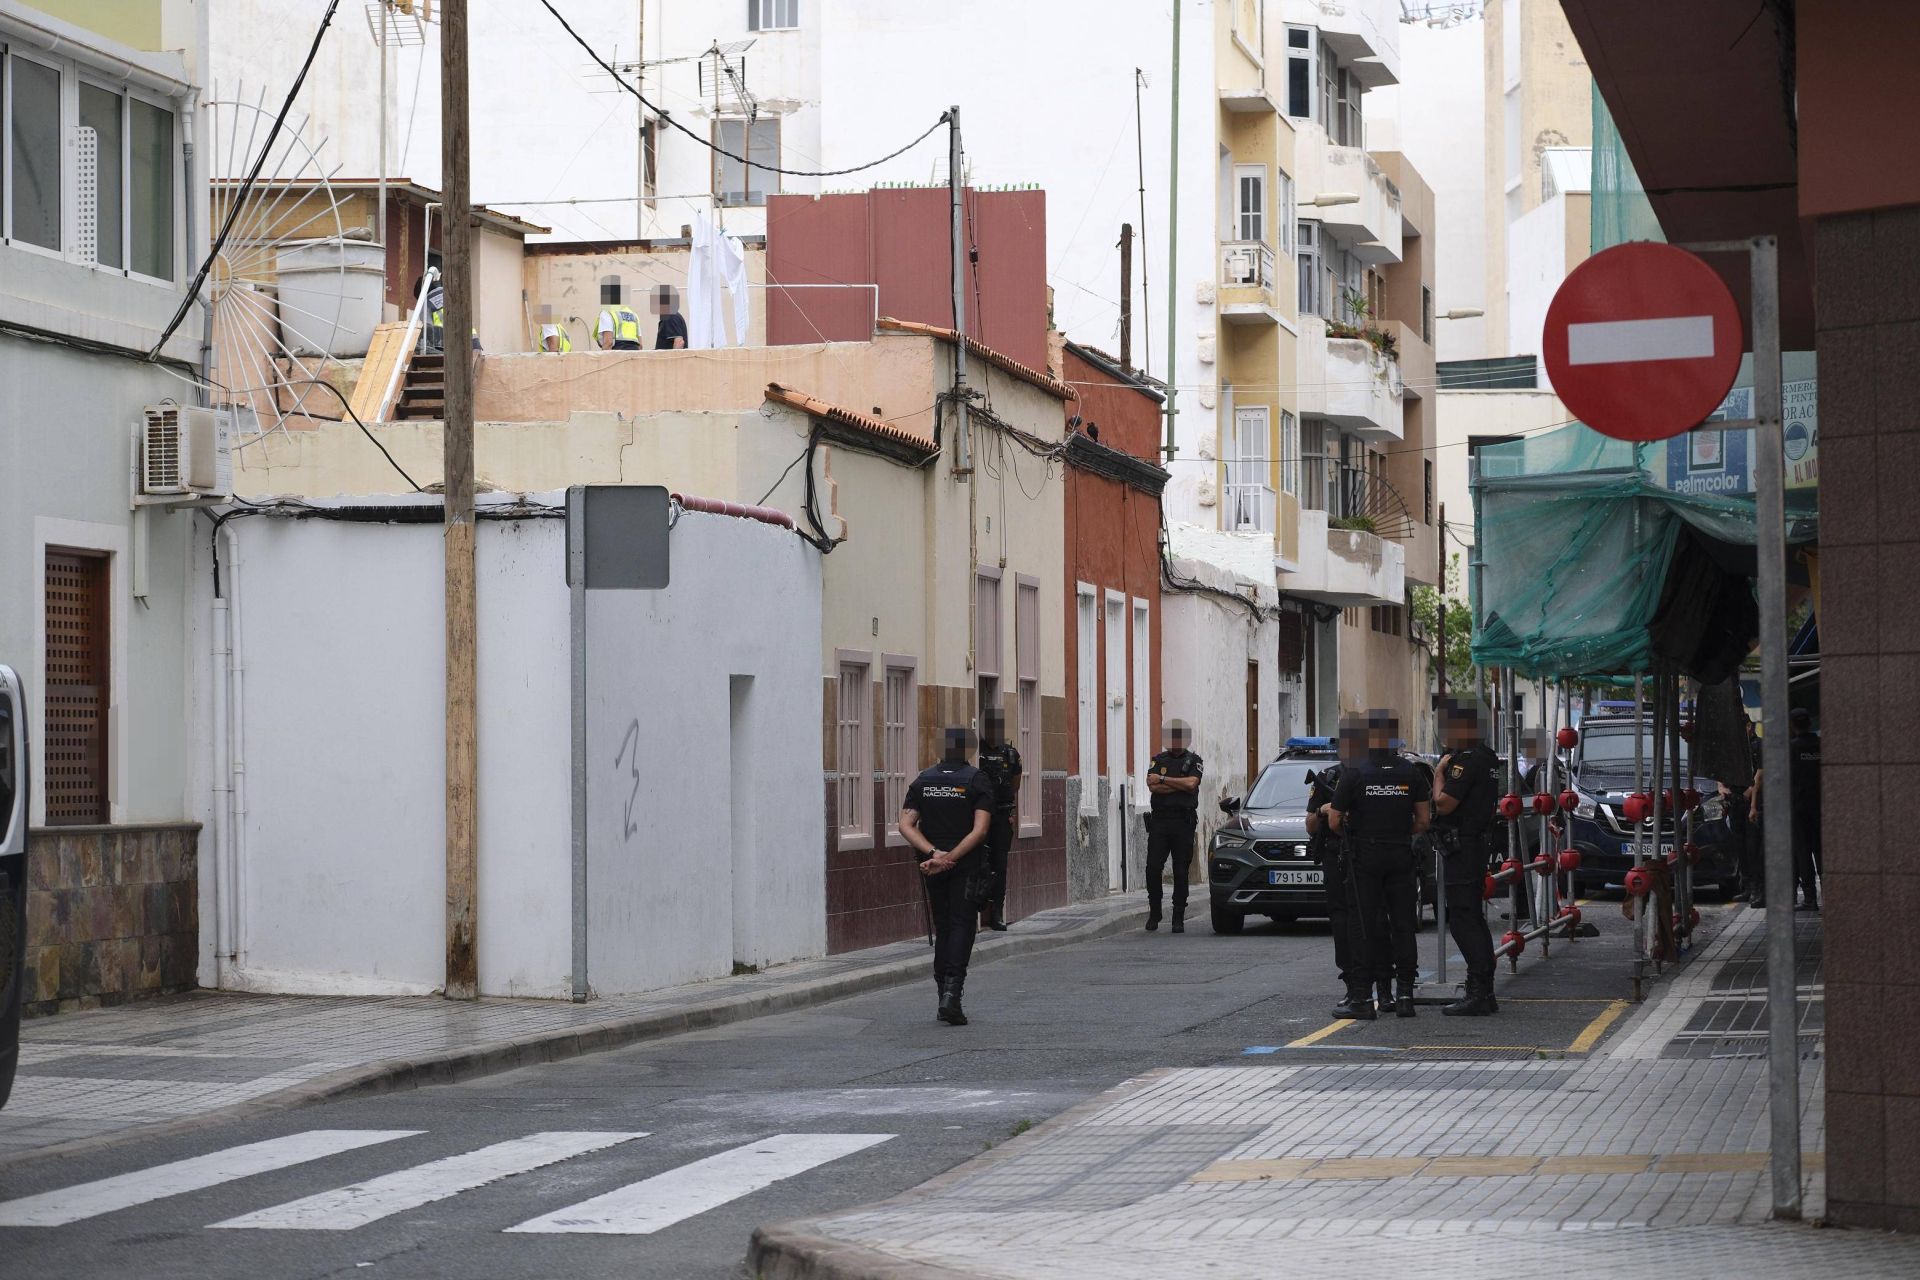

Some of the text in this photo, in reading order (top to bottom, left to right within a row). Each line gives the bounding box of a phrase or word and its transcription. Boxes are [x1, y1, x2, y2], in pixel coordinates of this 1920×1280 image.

[1675, 474, 1740, 492] palmcolor
[1276, 873, 1323, 883] 7915 MD
